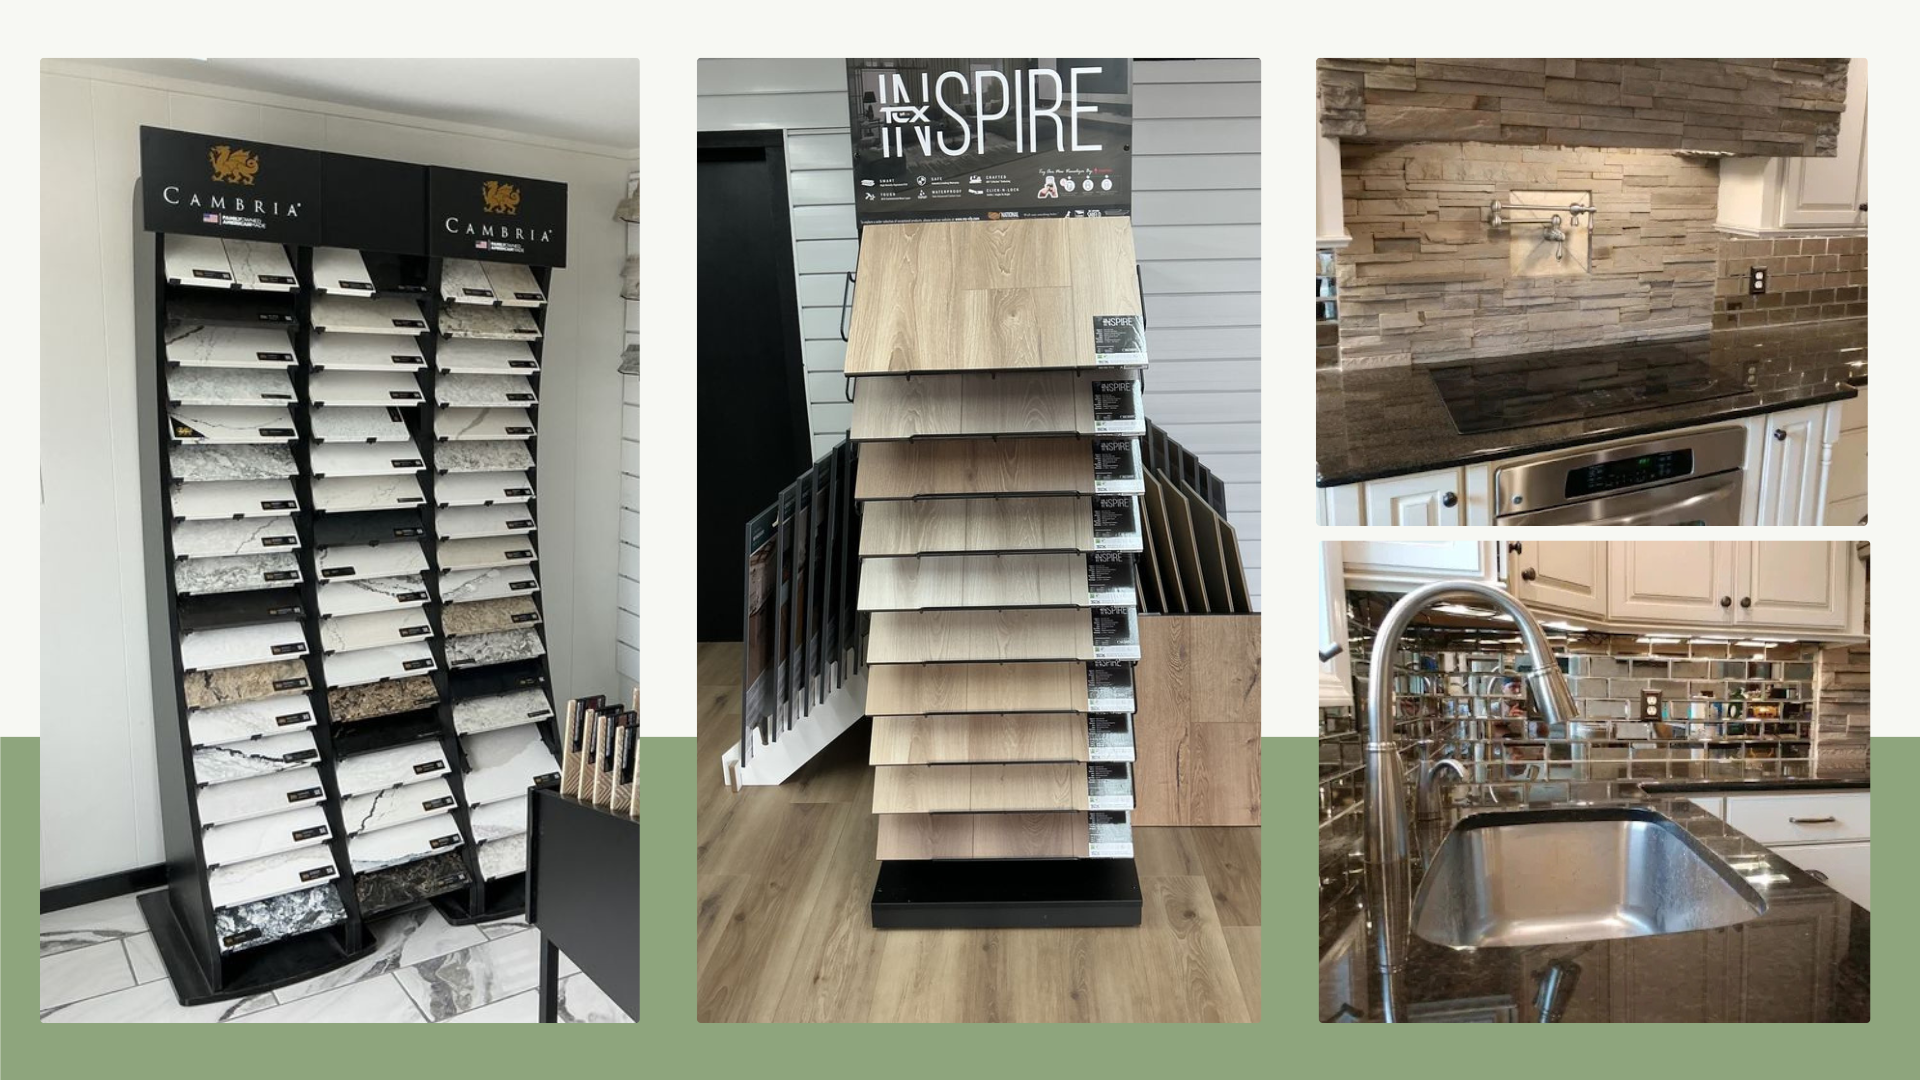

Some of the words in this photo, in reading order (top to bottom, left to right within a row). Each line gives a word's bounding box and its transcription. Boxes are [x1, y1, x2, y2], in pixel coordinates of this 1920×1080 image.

[878, 66, 1103, 158] INSPIRE
[163, 185, 298, 217] CAMBRIA
[445, 216, 549, 242] CAMBRIA
[1101, 382, 1131, 392] INSPIRE
[1101, 442, 1130, 452] INSPIRE
[1100, 498, 1129, 508] INSPIRE
